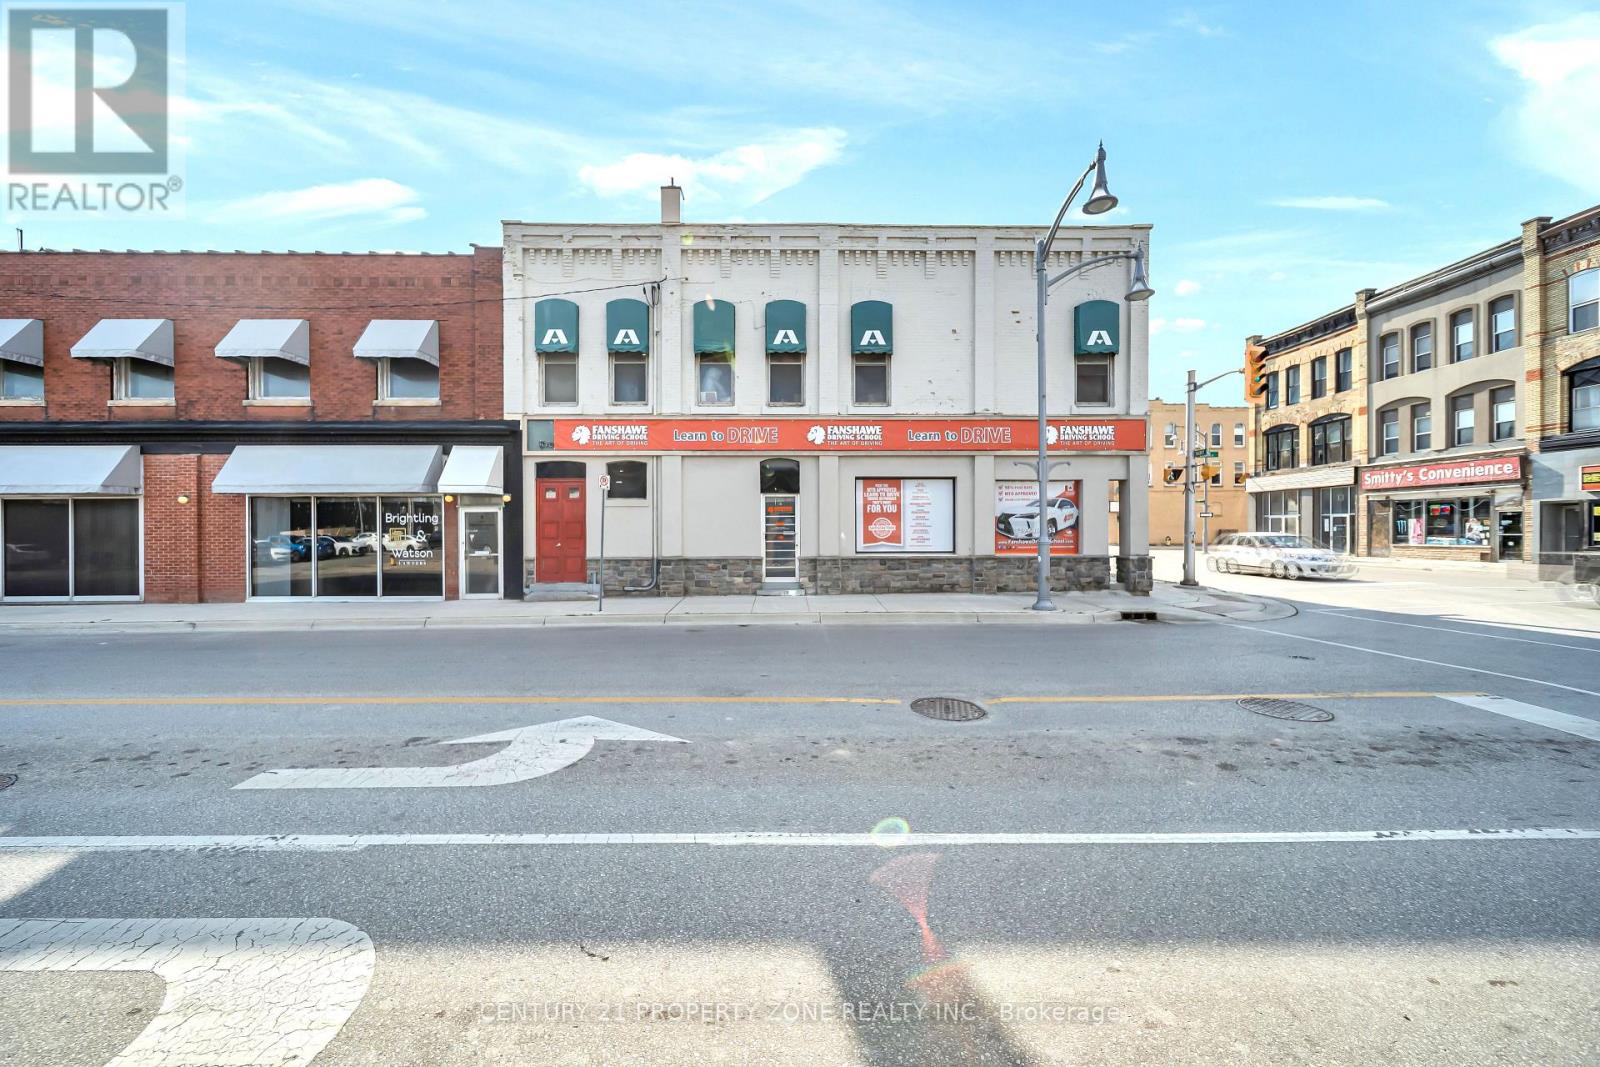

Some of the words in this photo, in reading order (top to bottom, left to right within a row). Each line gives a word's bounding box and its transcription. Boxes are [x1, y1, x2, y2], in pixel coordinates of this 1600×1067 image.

[592, 425, 648, 435] FANSHAWE
[673, 429, 708, 442] Learn
[711, 430, 725, 442] to
[727, 426, 779, 443] DRIVE
[827, 425, 882, 435] FANSHAWE
[907, 429, 942, 442] Learn
[945, 430, 958, 442] to
[960, 426, 1012, 443] DRIVE
[1060, 425, 1115, 435] FANSHAWE
[1364, 470, 1414, 486] Smitty's
[1418, 463, 1514, 481] Convenience
[867, 504, 881, 513] FOR
[882, 504, 897, 513] YOU
[385, 512, 439, 526] Brightling
[416, 530, 427, 542] &
[391, 548, 433, 558] Watson
